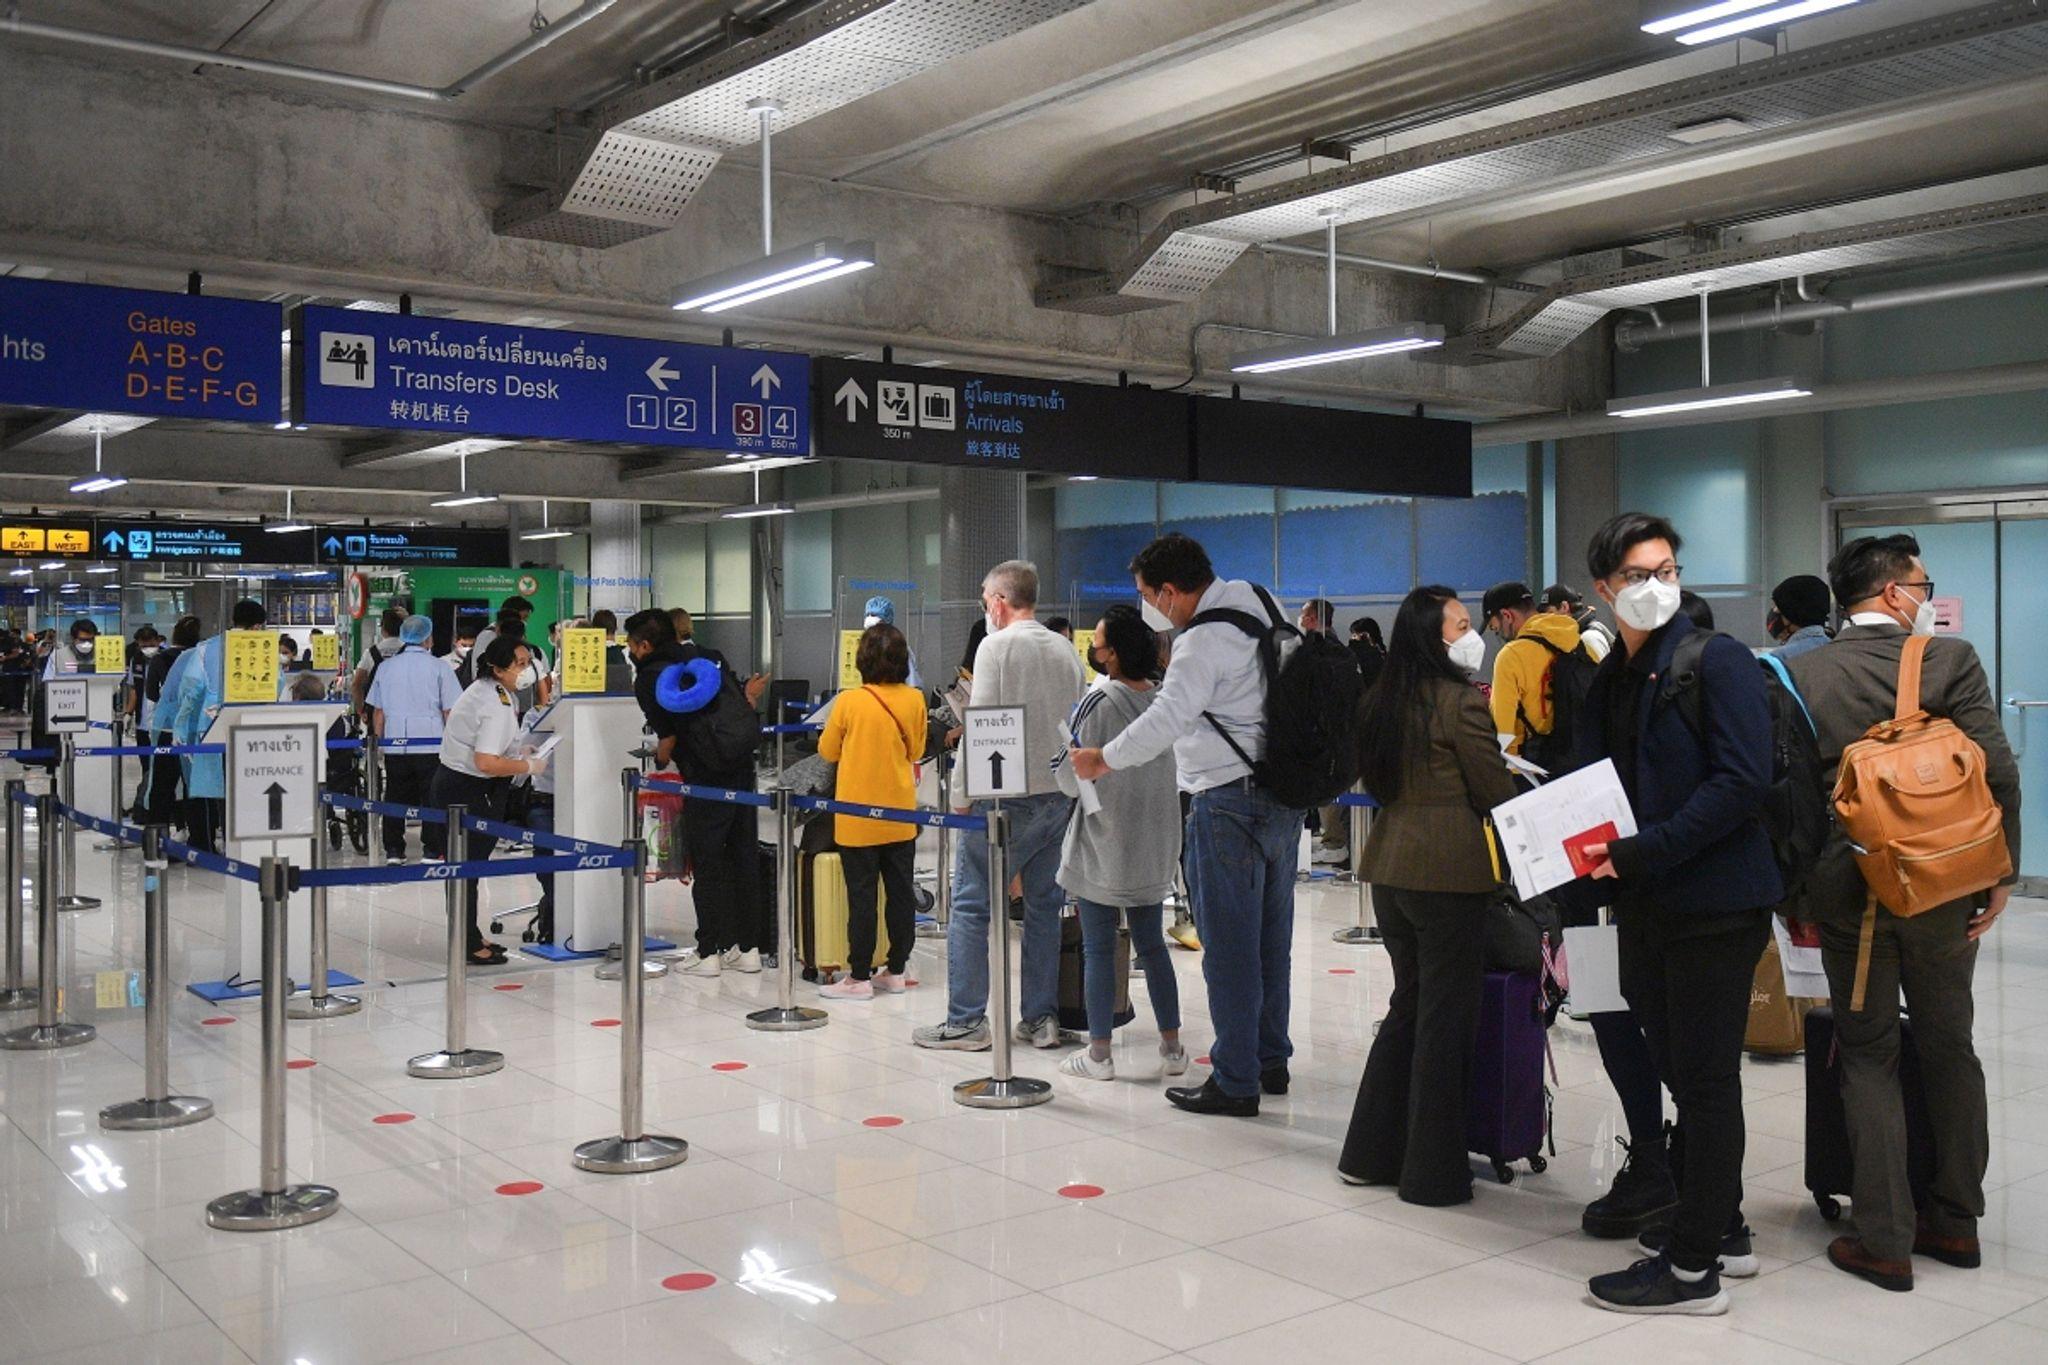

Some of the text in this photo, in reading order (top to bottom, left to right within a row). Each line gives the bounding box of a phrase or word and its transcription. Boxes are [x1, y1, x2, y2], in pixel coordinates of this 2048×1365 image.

[128, 311, 196, 337] Gates
[129, 341, 224, 372] A-B-C
[389, 331, 607, 372] เคาน์เตอร์เปลี่ยนเครื่อง
[127, 373, 259, 407] D-E-F-G
[389, 365, 559, 400] Transfers Desk
[964, 379, 1065, 410] ผู้โดยสารขาเข้า
[390, 399, 470, 424] 转机柜台
[636, 401, 688, 426] 1 2
[740, 409, 790, 434] 3 4
[966, 413, 1024, 433] Arrivals
[966, 440, 1021, 459] 旅客到达
[10, 541, 36, 549] EAST
[55, 542, 83, 551] WEST
[155, 545, 203, 556] Immigration
[974, 712, 1015, 728] ทางเข้า
[247, 734, 301, 753] ทางเข้า
[972, 737, 1017, 747] ENTRANCE
[244, 765, 305, 777] ENTRANCE
[577, 854, 614, 868] AOT
[423, 865, 462, 879] AOT
